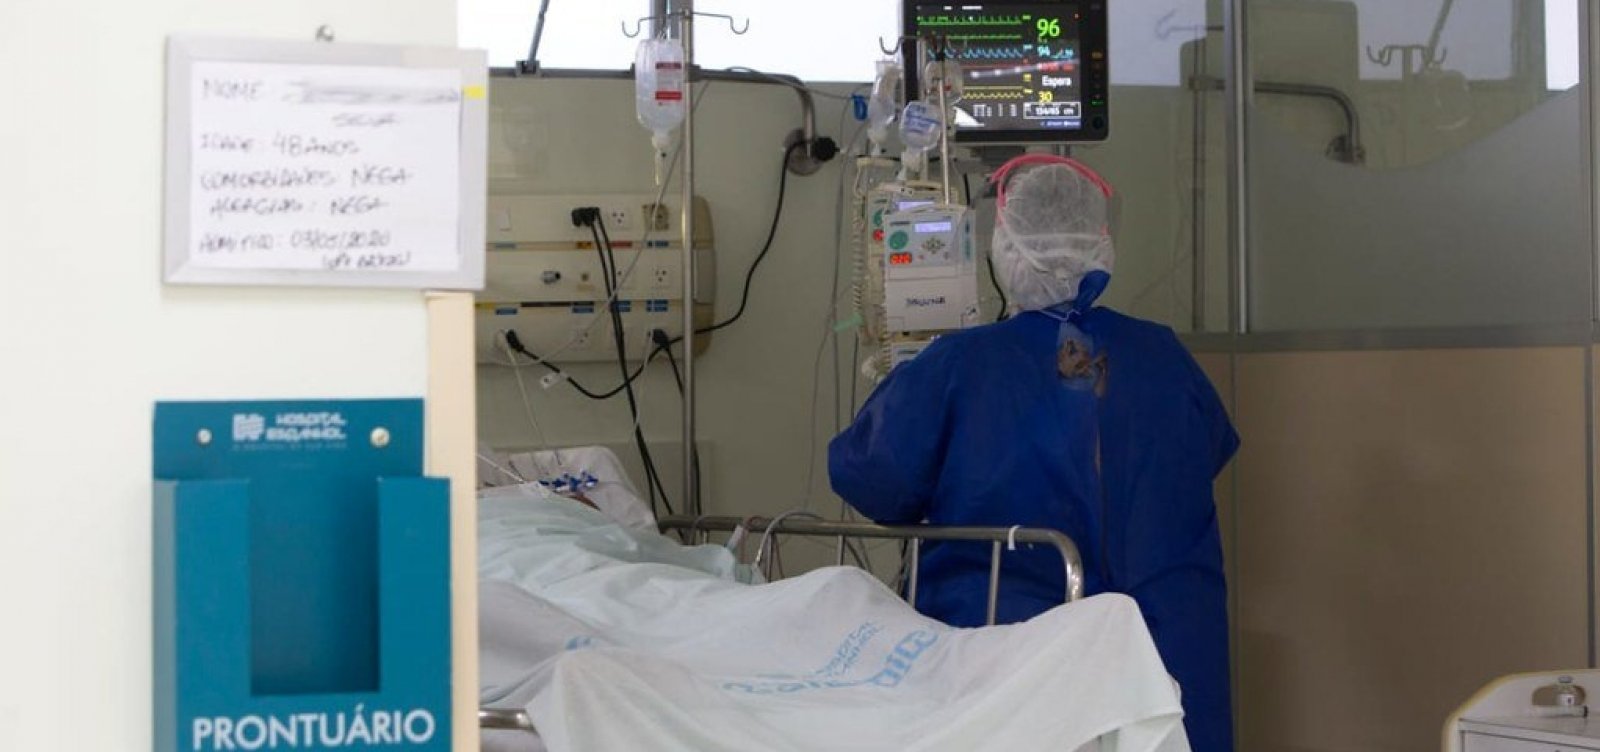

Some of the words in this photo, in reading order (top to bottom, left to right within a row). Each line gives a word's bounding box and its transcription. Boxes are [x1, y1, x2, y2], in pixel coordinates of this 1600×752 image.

[1037, 18, 1060, 37] 96
[1039, 91, 1053, 103] 30
[275, 412, 347, 426] HOSPITAL
[193, 703, 435, 751] PRONTUÁRIO
